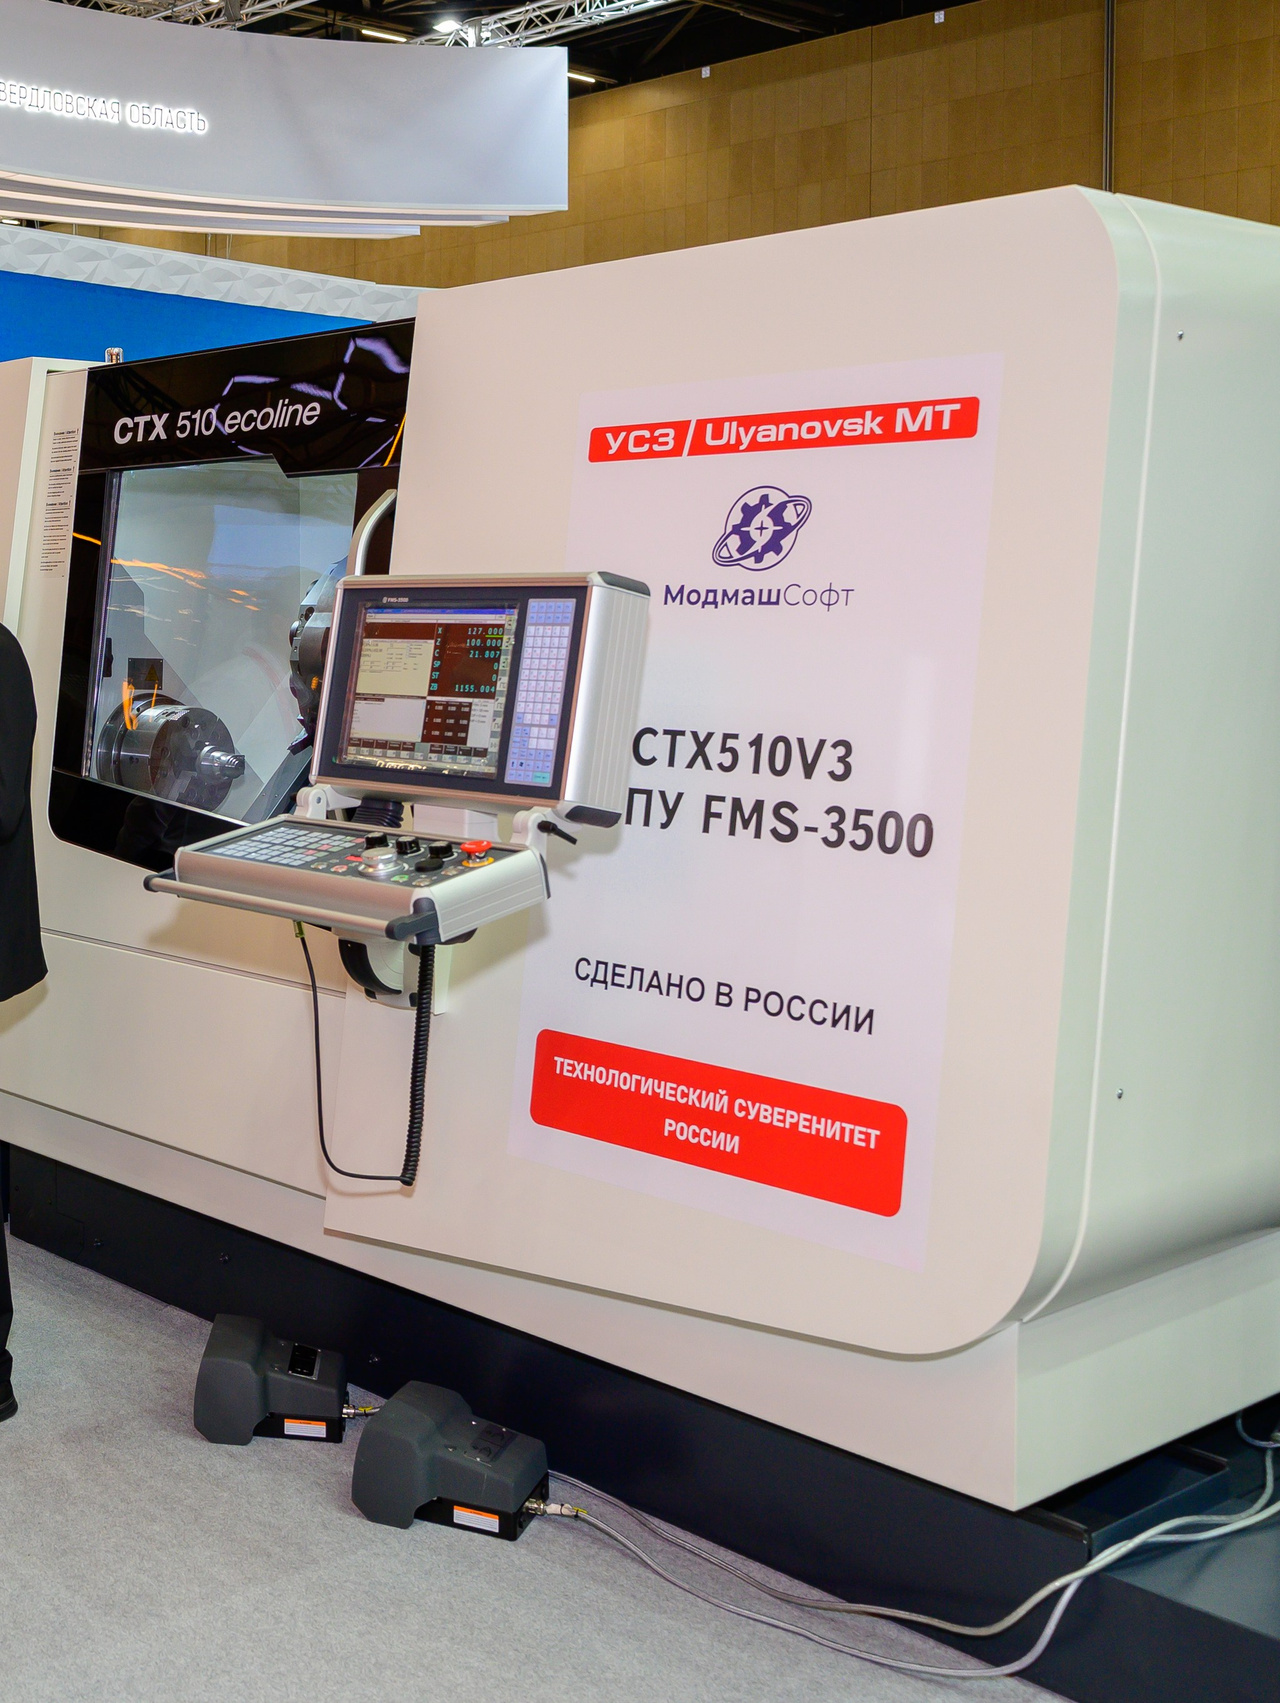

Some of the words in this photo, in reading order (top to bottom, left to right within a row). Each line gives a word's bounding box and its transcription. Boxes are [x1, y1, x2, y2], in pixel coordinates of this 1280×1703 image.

[128, 102, 208, 133] ОБЛАСТЬ
[113, 412, 170, 445] CTX
[176, 407, 217, 439] 510
[224, 398, 321, 434] ecoline
[704, 410, 884, 451] Ulyanovsk
[894, 403, 962, 434] MT
[663, 582, 855, 612] МодмашСофт
[632, 726, 854, 782] CTX510V3
[624, 787, 685, 830] ПУ
[701, 794, 934, 858] FMS-3500
[574, 957, 706, 1003] СДЕЛАНО
[714, 981, 734, 1008] В
[743, 986, 875, 1036] РОССИИ
[553, 1055, 729, 1115] ТЕХНОЛОГИЧЕСКИЙ
[733, 1097, 881, 1150] СУВЕРЕНИТЕТ
[663, 1118, 740, 1155] РОССИИ
